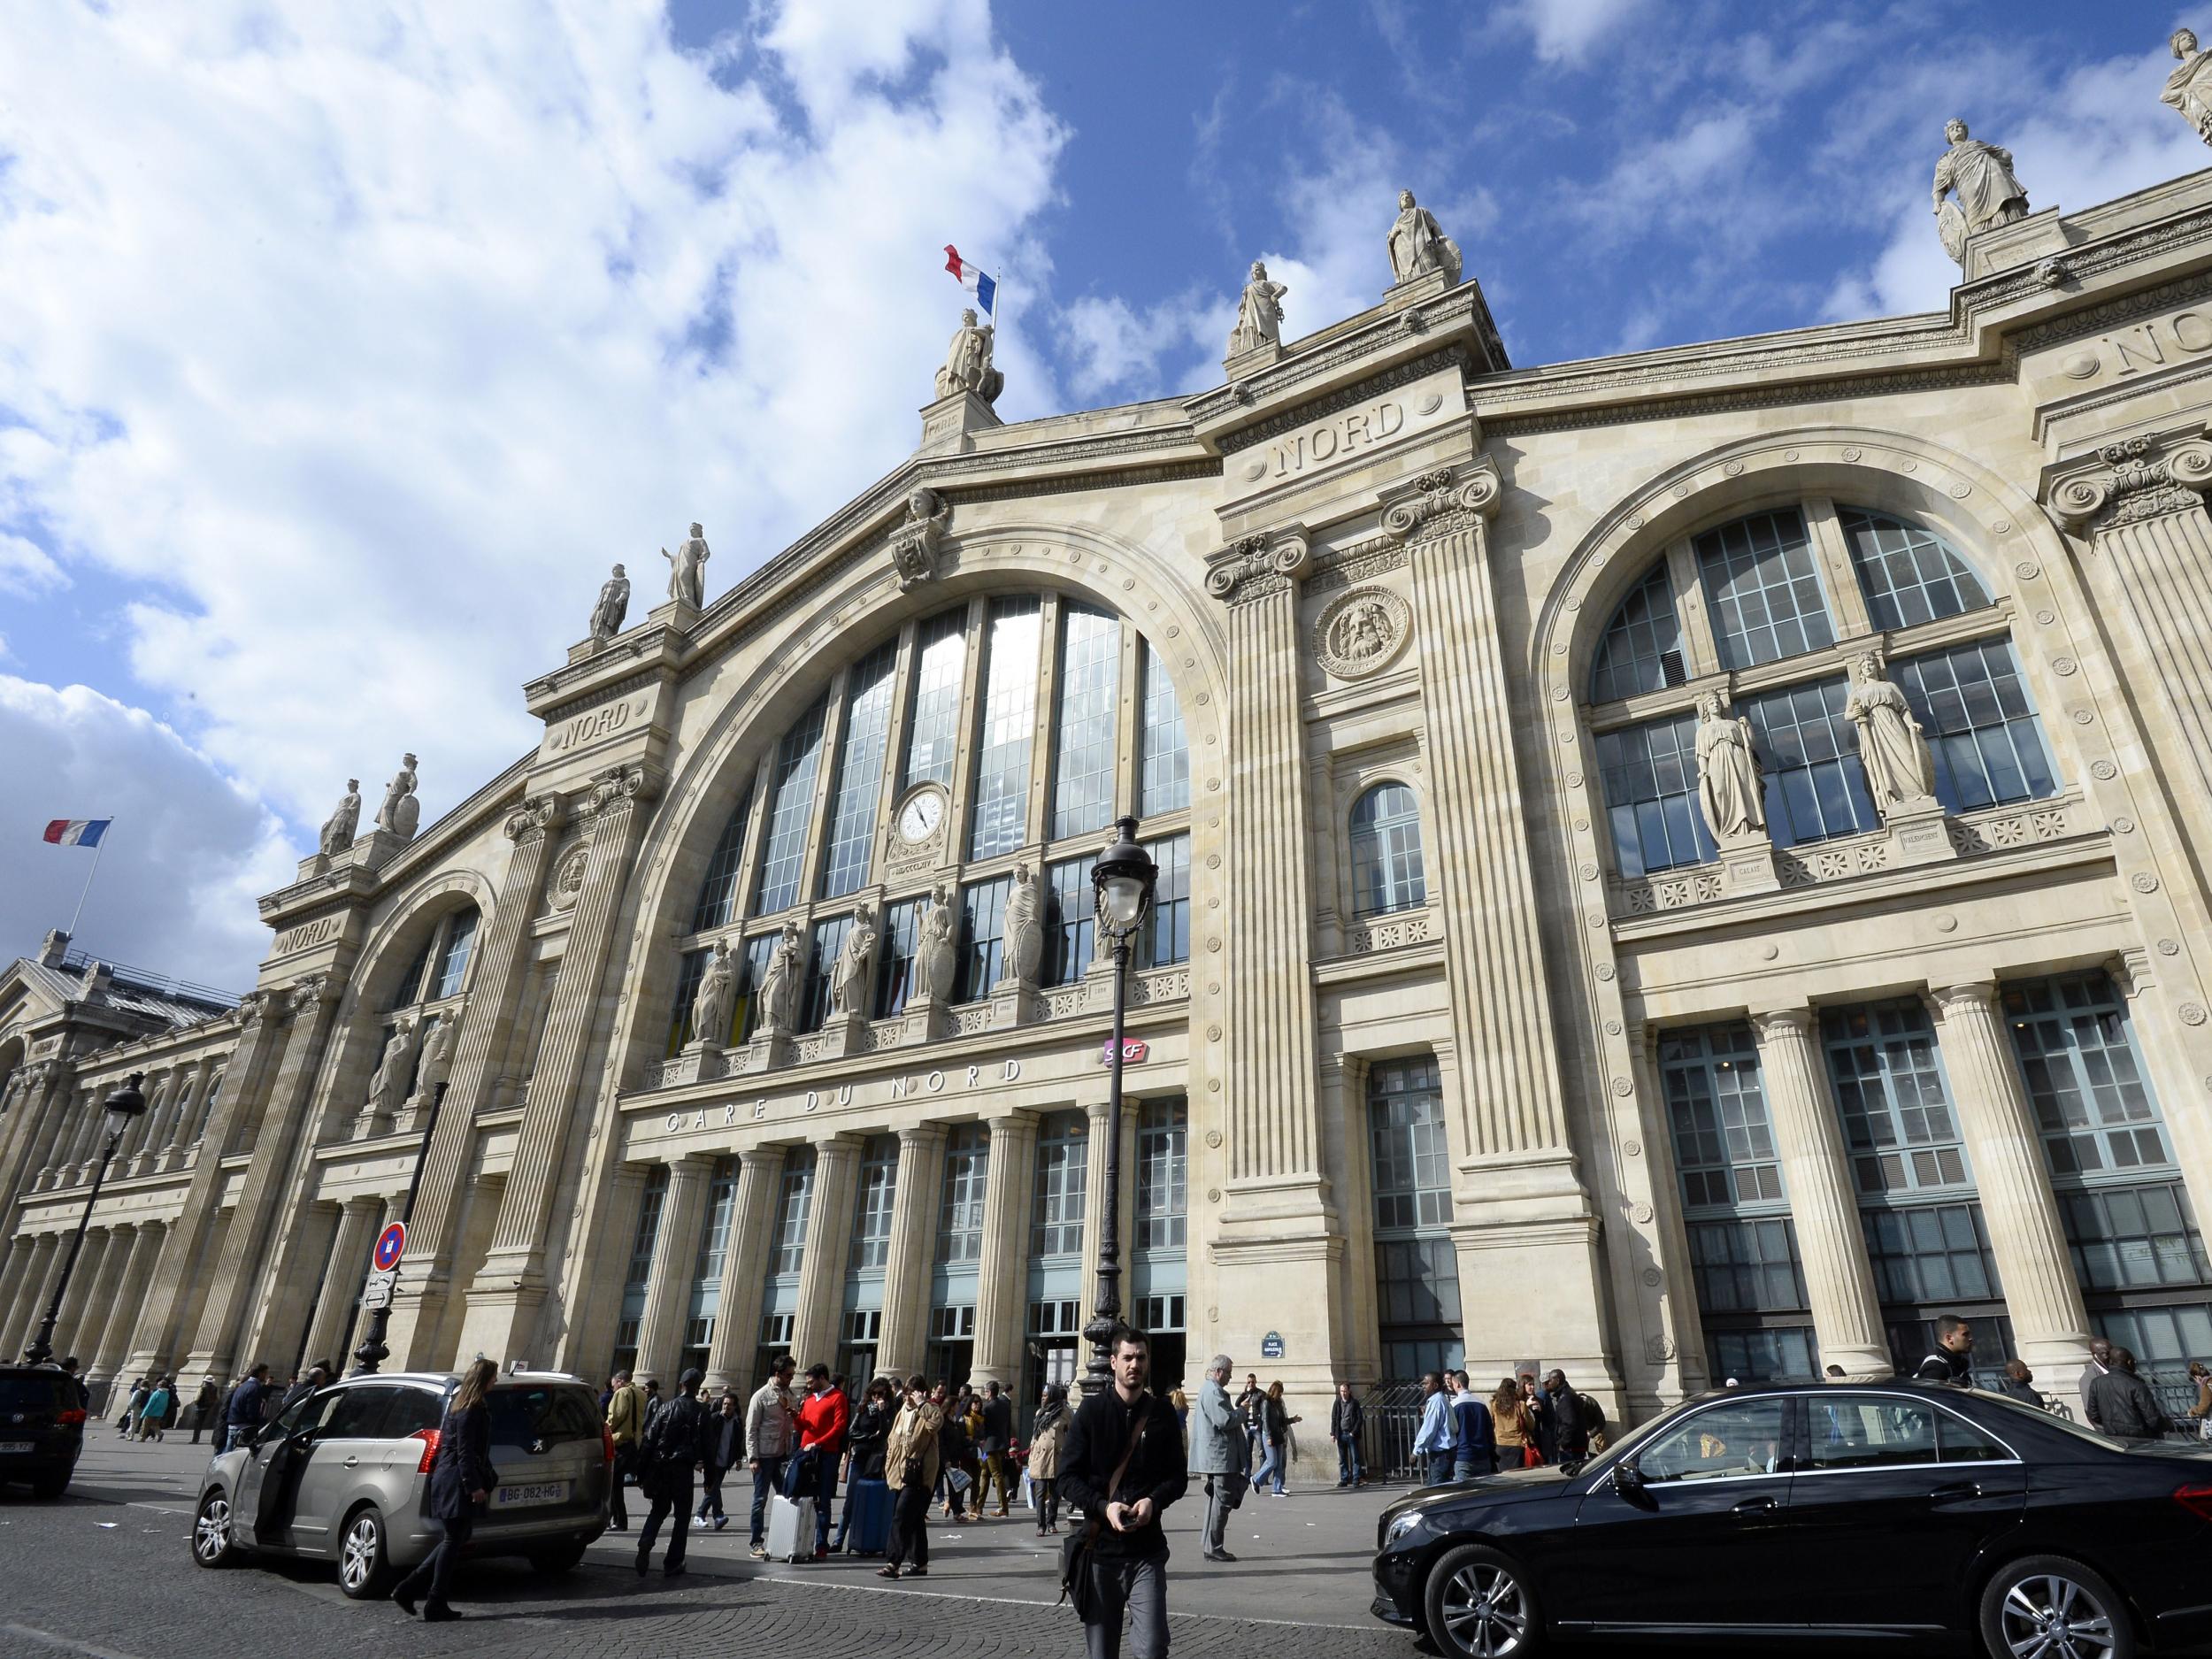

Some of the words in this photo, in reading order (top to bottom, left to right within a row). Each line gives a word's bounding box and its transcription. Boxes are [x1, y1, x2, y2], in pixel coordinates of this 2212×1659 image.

[927, 414, 958, 436] PARIS
[1272, 403, 1404, 479] NORD
[561, 702, 630, 750] NORD
[280, 918, 332, 955] NORD
[1104, 1044, 1143, 1062] SCF
[665, 1099, 766, 1133] GARE
[805, 1084, 853, 1111] DU
[891, 1059, 1020, 1099] NORD
[507, 1486, 556, 1502] BG-082-HG
